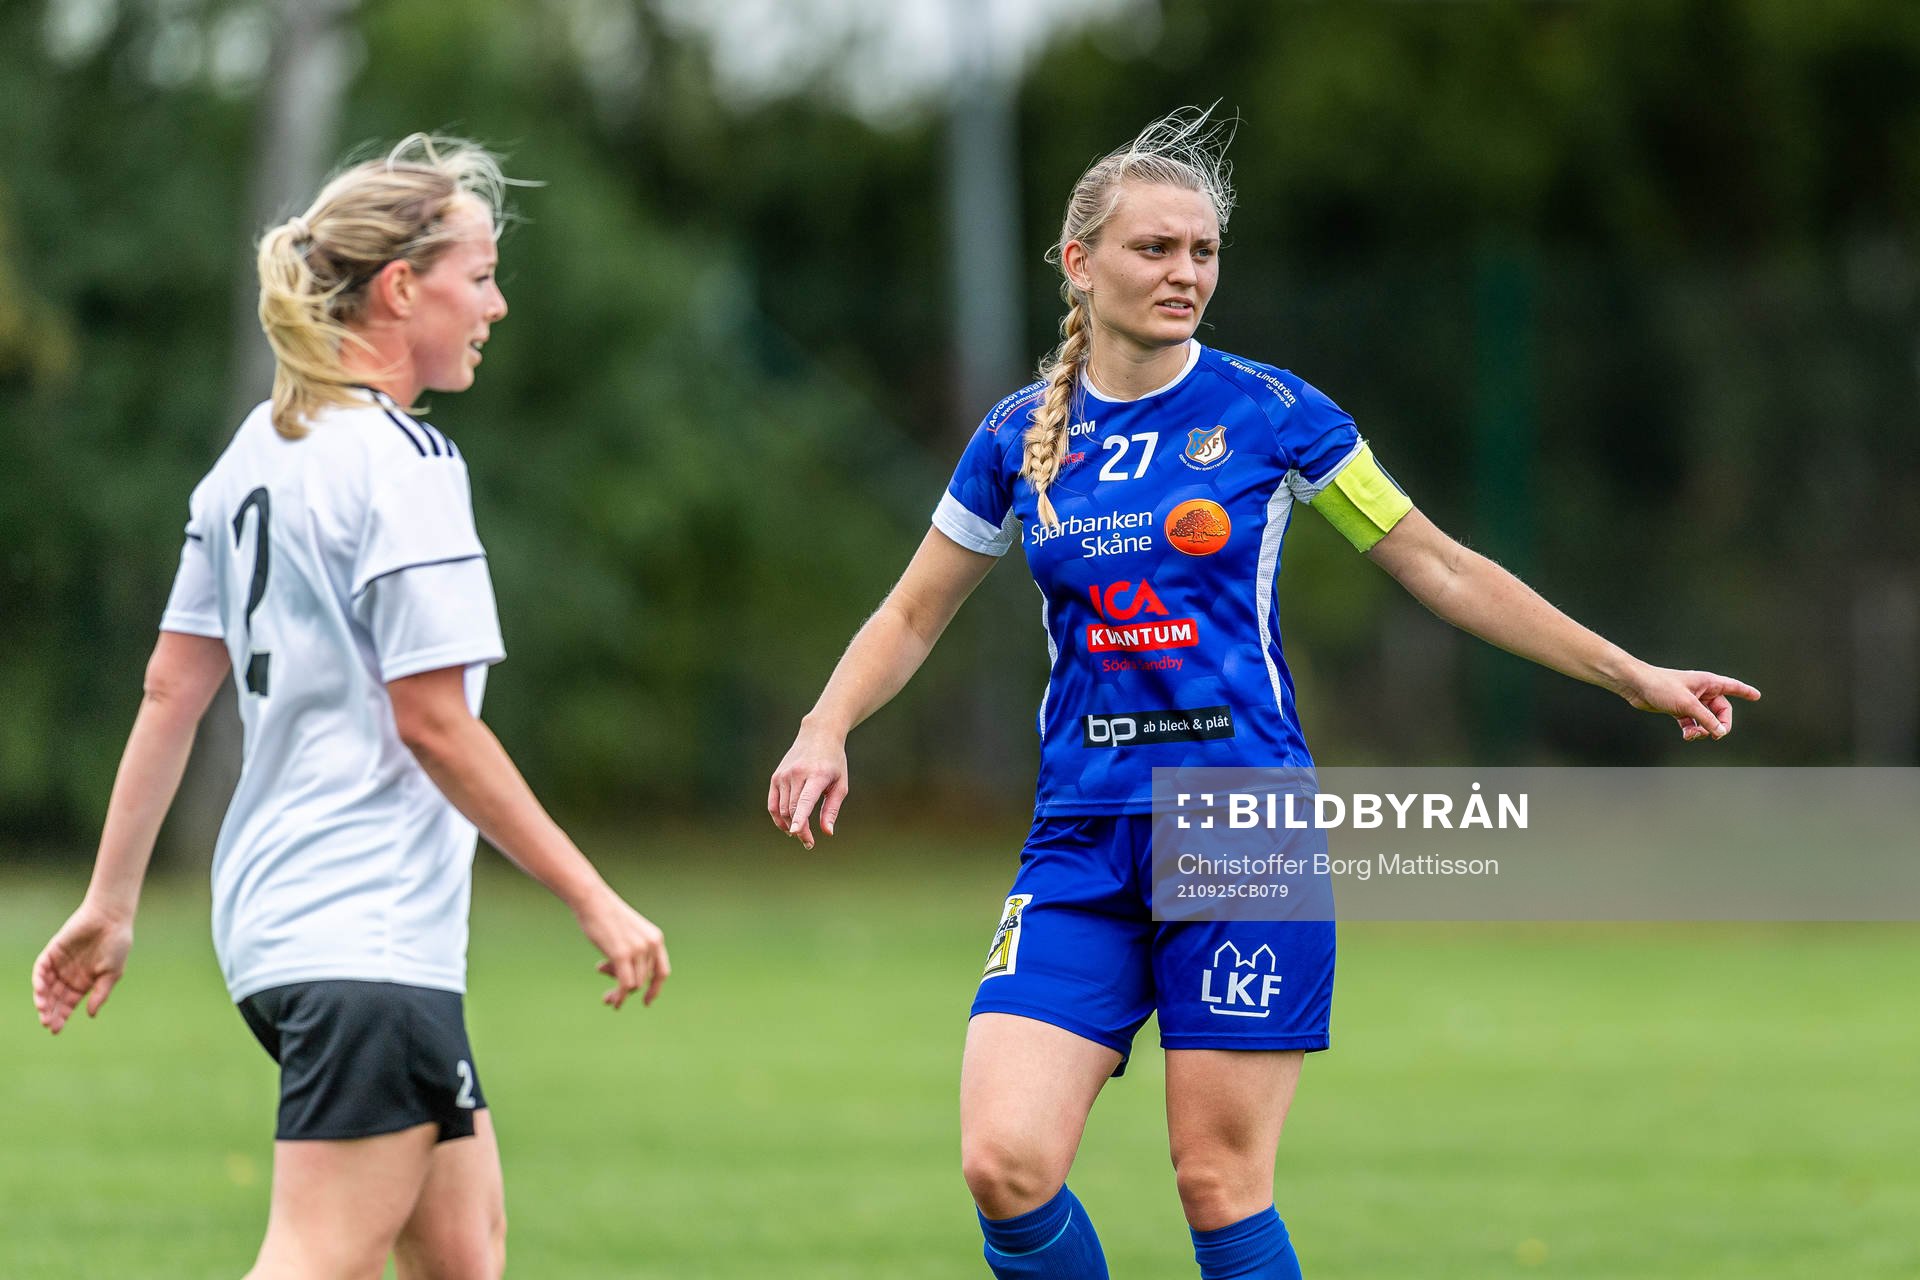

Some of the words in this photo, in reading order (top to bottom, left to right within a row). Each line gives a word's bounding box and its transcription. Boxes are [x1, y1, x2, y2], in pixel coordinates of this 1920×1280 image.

[1019, 378, 1049, 396] Analy
[1229, 360, 1256, 375] Martin
[1256, 371, 1297, 404] Lindström
[1098, 431, 1159, 482] 27
[1031, 511, 1153, 547] Sparbanken
[1081, 533, 1152, 558] Skåne
[233, 487, 271, 697] 2
[1088, 578, 1170, 621] ICA
[1087, 714, 1137, 747] bp
[1143, 721, 1156, 733] ab
[1159, 718, 1190, 732] bleck
[1192, 718, 1202, 730] &
[1206, 714, 1230, 731] plåt
[1201, 969, 1283, 1007] LKF
[455, 1059, 477, 1109] 2
